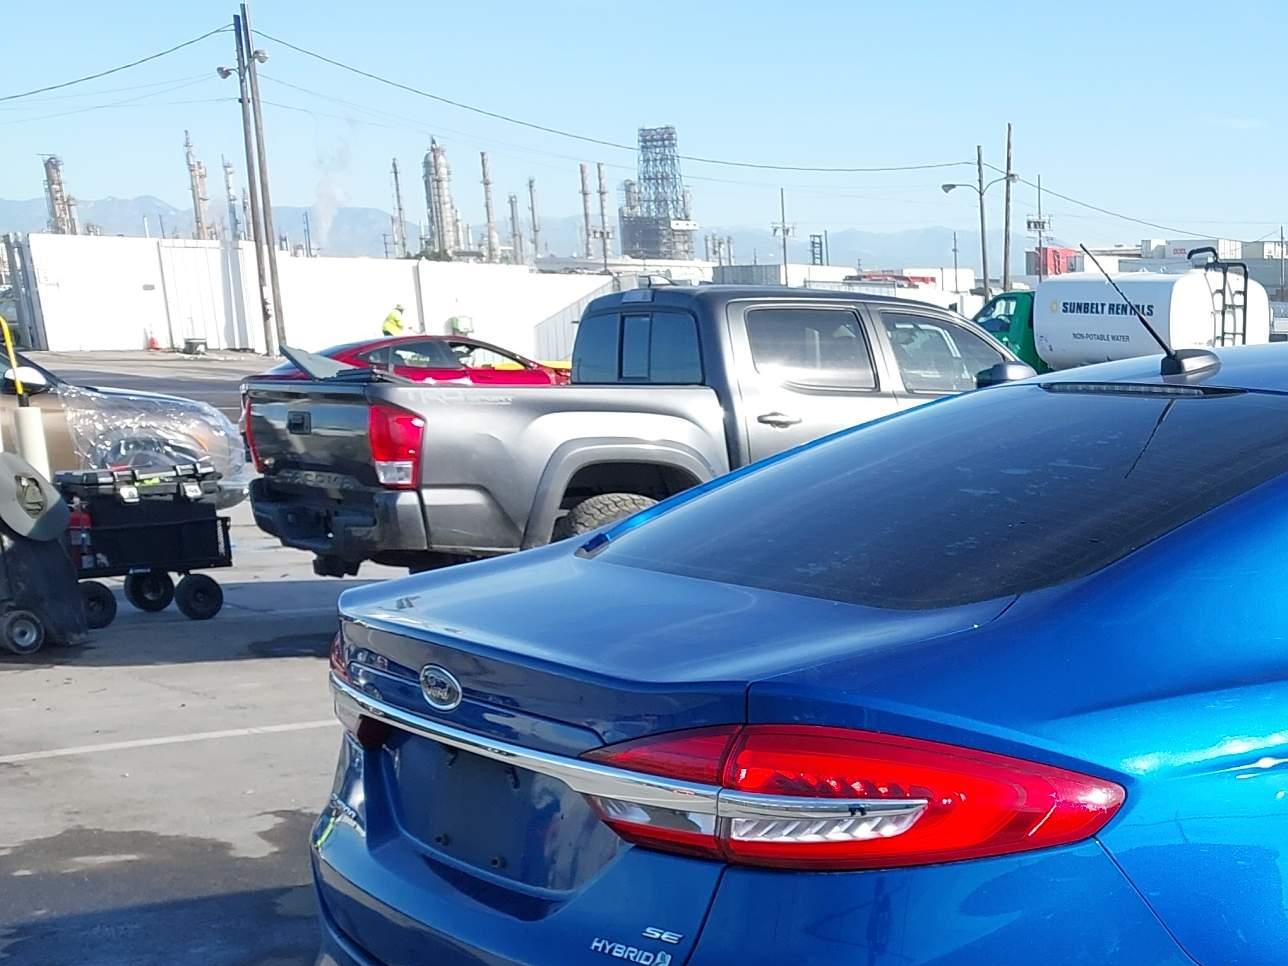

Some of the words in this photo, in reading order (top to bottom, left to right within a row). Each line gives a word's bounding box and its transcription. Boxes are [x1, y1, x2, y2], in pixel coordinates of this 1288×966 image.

[1062, 301, 1107, 316] SUNBELT
[1111, 334, 1131, 343] WATER
[641, 926, 685, 944] SE
[590, 937, 655, 966] HYBRID
